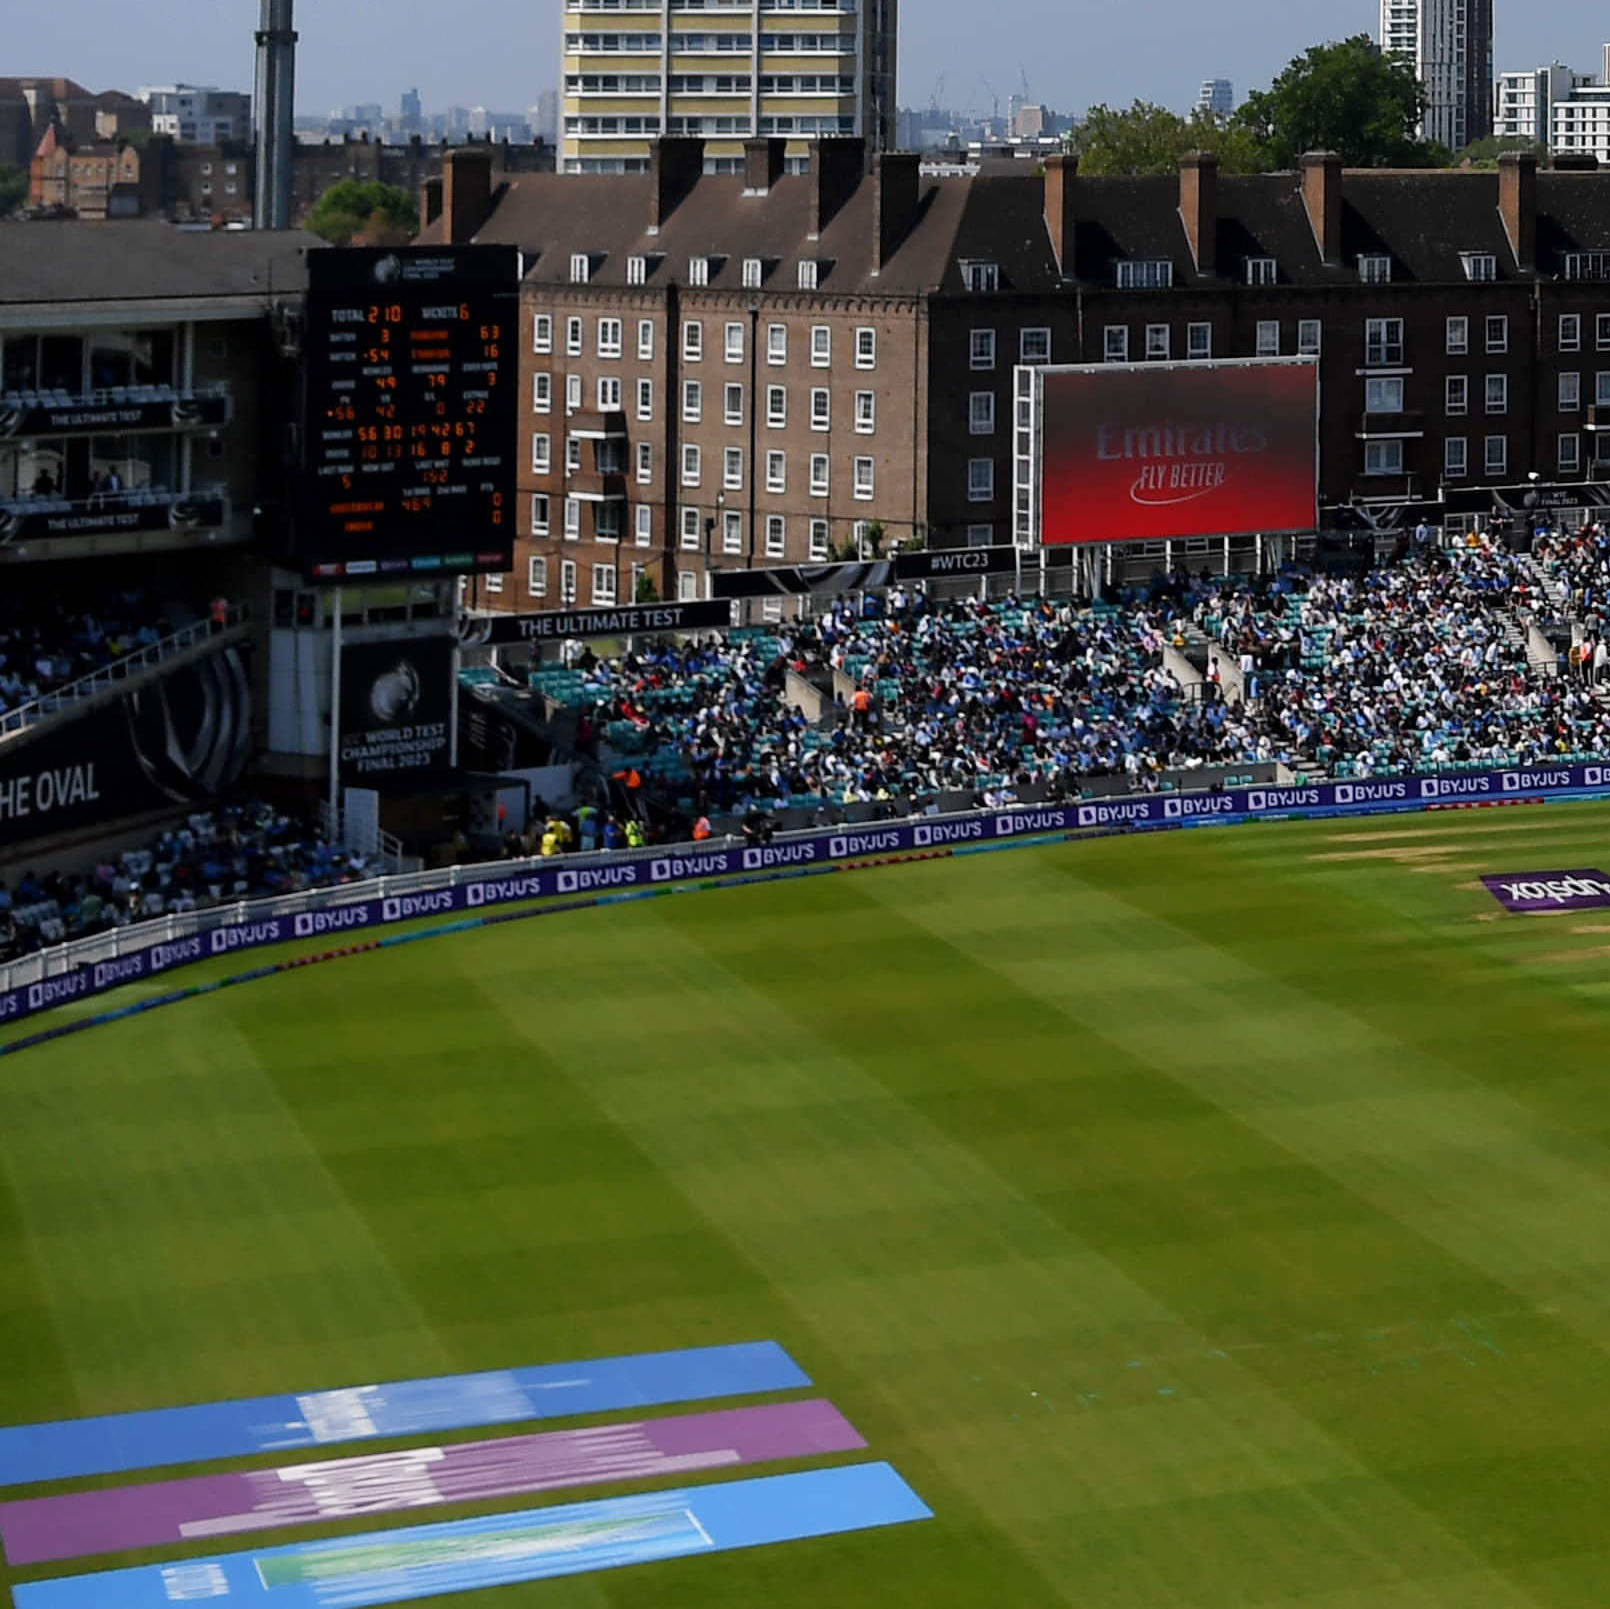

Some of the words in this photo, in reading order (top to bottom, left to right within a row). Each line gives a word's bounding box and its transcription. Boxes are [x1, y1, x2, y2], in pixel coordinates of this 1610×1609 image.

[331, 309, 365, 322] TOTAL
[368, 306, 401, 323] 210
[459, 304, 469, 320] 6
[382, 328, 389, 343] 3
[480, 325, 499, 339] 63
[484, 344, 498, 358] 16
[376, 376, 396, 389] 49
[488, 372, 496, 386] 3
[358, 427, 377, 440] 56
[1098, 419, 1267, 459] Emirates
[465, 440, 475, 454] 2
[1139, 465, 1167, 489] FLY
[1169, 463, 1225, 488] BETTER
[493, 493, 502, 506] 0
[493, 510, 501, 524] 0
[930, 554, 989, 570] #WTC23
[519, 619, 553, 637] THE
[557, 612, 640, 634] ULTIMATE
[644, 608, 683, 627] TEST
[366, 727, 412, 742] WORLD
[416, 724, 446, 737] TEST
[342, 737, 446, 760] CHAMPIONSHIP
[357, 756, 396, 773] FINAL
[398, 752, 430, 768] 2023
[1439, 777, 1490, 795] BYJU'S
[1520, 772, 1570, 788] BYJU'S
[0, 773, 30, 820] HE
[36, 763, 99, 811] OVAL
[1268, 789, 1319, 807] BYJU'S
[1012, 812, 1064, 834] BYJU'S
[1096, 804, 1149, 824] BYJU'S
[849, 833, 900, 853] BYJU'S
[580, 865, 636, 885] BYJU'S
[672, 855, 727, 878] BYJU'S
[403, 892, 453, 917] BYJU'S
[227, 922, 279, 947] BYJU'S
